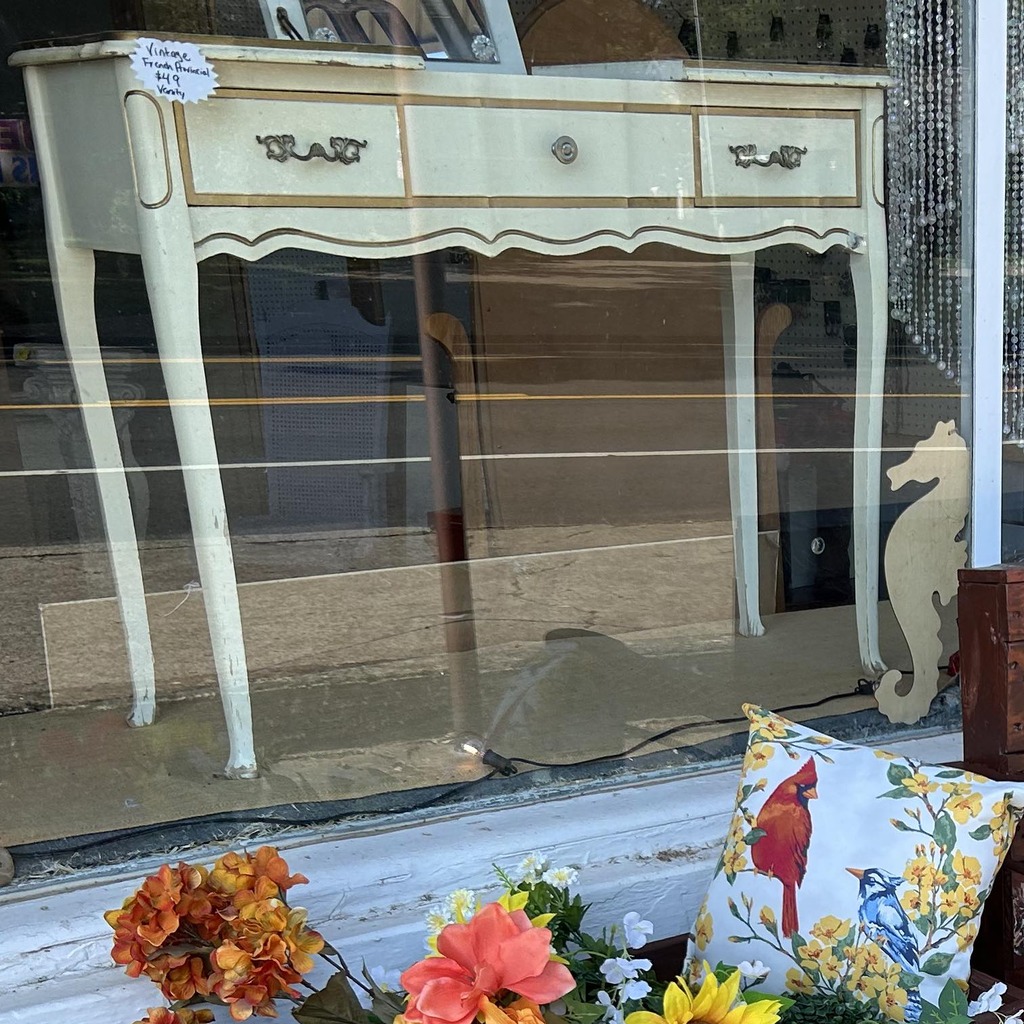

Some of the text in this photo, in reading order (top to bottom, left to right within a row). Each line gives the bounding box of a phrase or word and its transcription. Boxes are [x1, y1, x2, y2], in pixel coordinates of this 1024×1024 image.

[146, 42, 191, 62] Vintage
[142, 57, 210, 77] French Provincial
[155, 70, 181, 87] $49
[157, 84, 185, 99] Vanity
